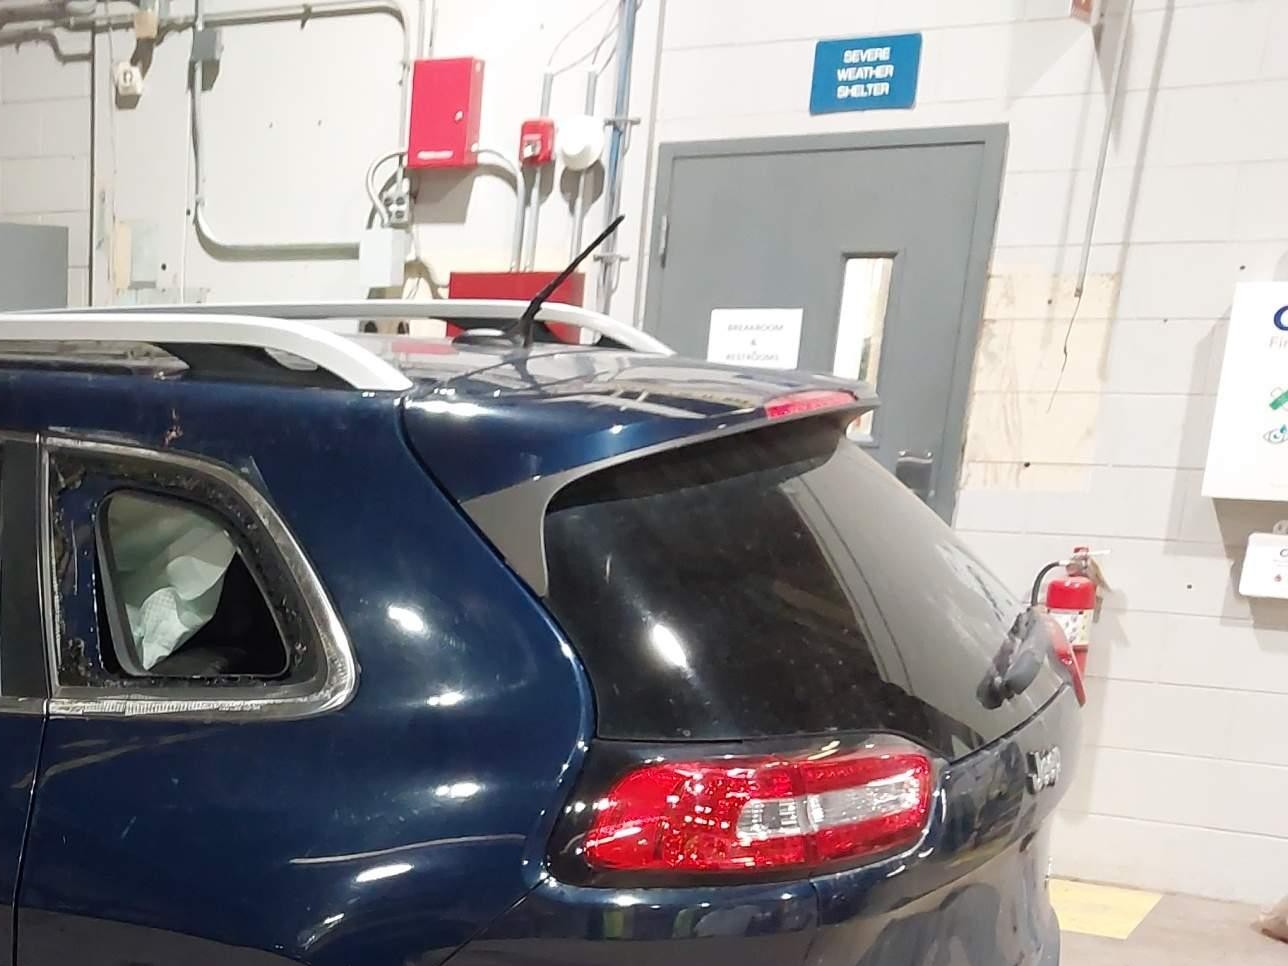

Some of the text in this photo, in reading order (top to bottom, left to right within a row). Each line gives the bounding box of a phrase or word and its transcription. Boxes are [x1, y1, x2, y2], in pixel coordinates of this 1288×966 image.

[843, 47, 891, 64] SEVERE
[837, 64, 894, 82] WEATHER
[836, 82, 890, 99] SHELTER
